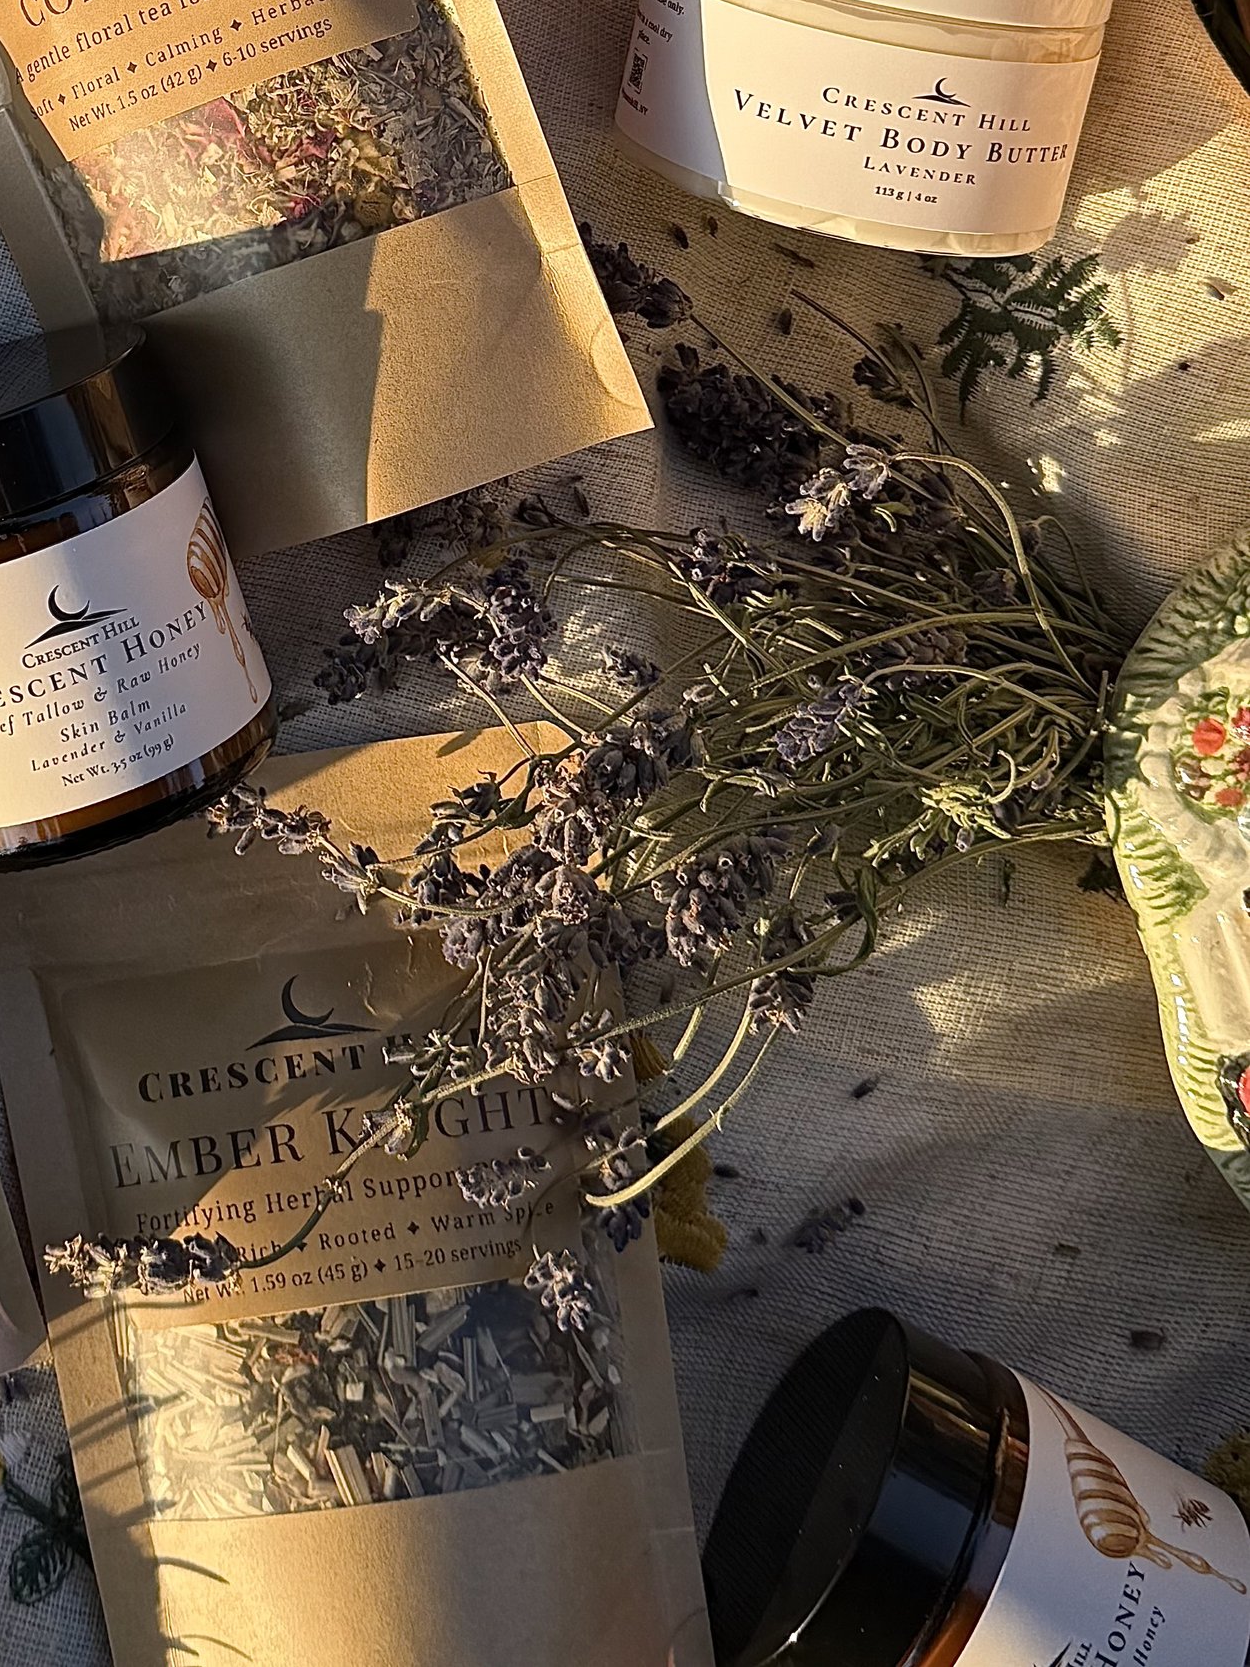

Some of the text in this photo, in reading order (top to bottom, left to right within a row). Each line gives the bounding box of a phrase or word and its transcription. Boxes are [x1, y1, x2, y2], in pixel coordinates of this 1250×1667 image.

[27, 45, 70, 82] gentle
[76, 9, 133, 54] floral
[139, 1, 172, 25] tea
[72, 67, 120, 100] Floral
[145, 28, 223, 67] Calming
[69, 108, 91, 131] Net
[118, 92, 137, 112] 1.5
[142, 87, 158, 101] oz
[161, 70, 186, 97] (42
[188, 64, 203, 88] g)
[223, 43, 256, 67] 6-10
[259, 18, 333, 54] servings
[734, 89, 1068, 163] VELVET BODY BUTTER
[823, 87, 1031, 132] CRESCENT HILL
[863, 156, 976, 186] LAVENDER
[22, 616, 139, 670] CRESCENT HILL
[121, 601, 207, 664] HONEY
[23, 695, 84, 727] Tallow
[94, 687, 107, 702] &
[117, 671, 151, 694] Raw
[158, 641, 202, 673] Honey
[31, 703, 187, 772] Lavender & Vanilla
[61, 698, 151, 743] Skin Balm
[138, 1044, 365, 1103] CRESCENT
[109, 1086, 549, 1188] EMBER KGHT
[138, 1199, 255, 1233] Fortifying
[319, 1212, 495, 1250] Rooted Warm
[183, 1238, 522, 1303] Net 1.59 oz (45 g) servings
